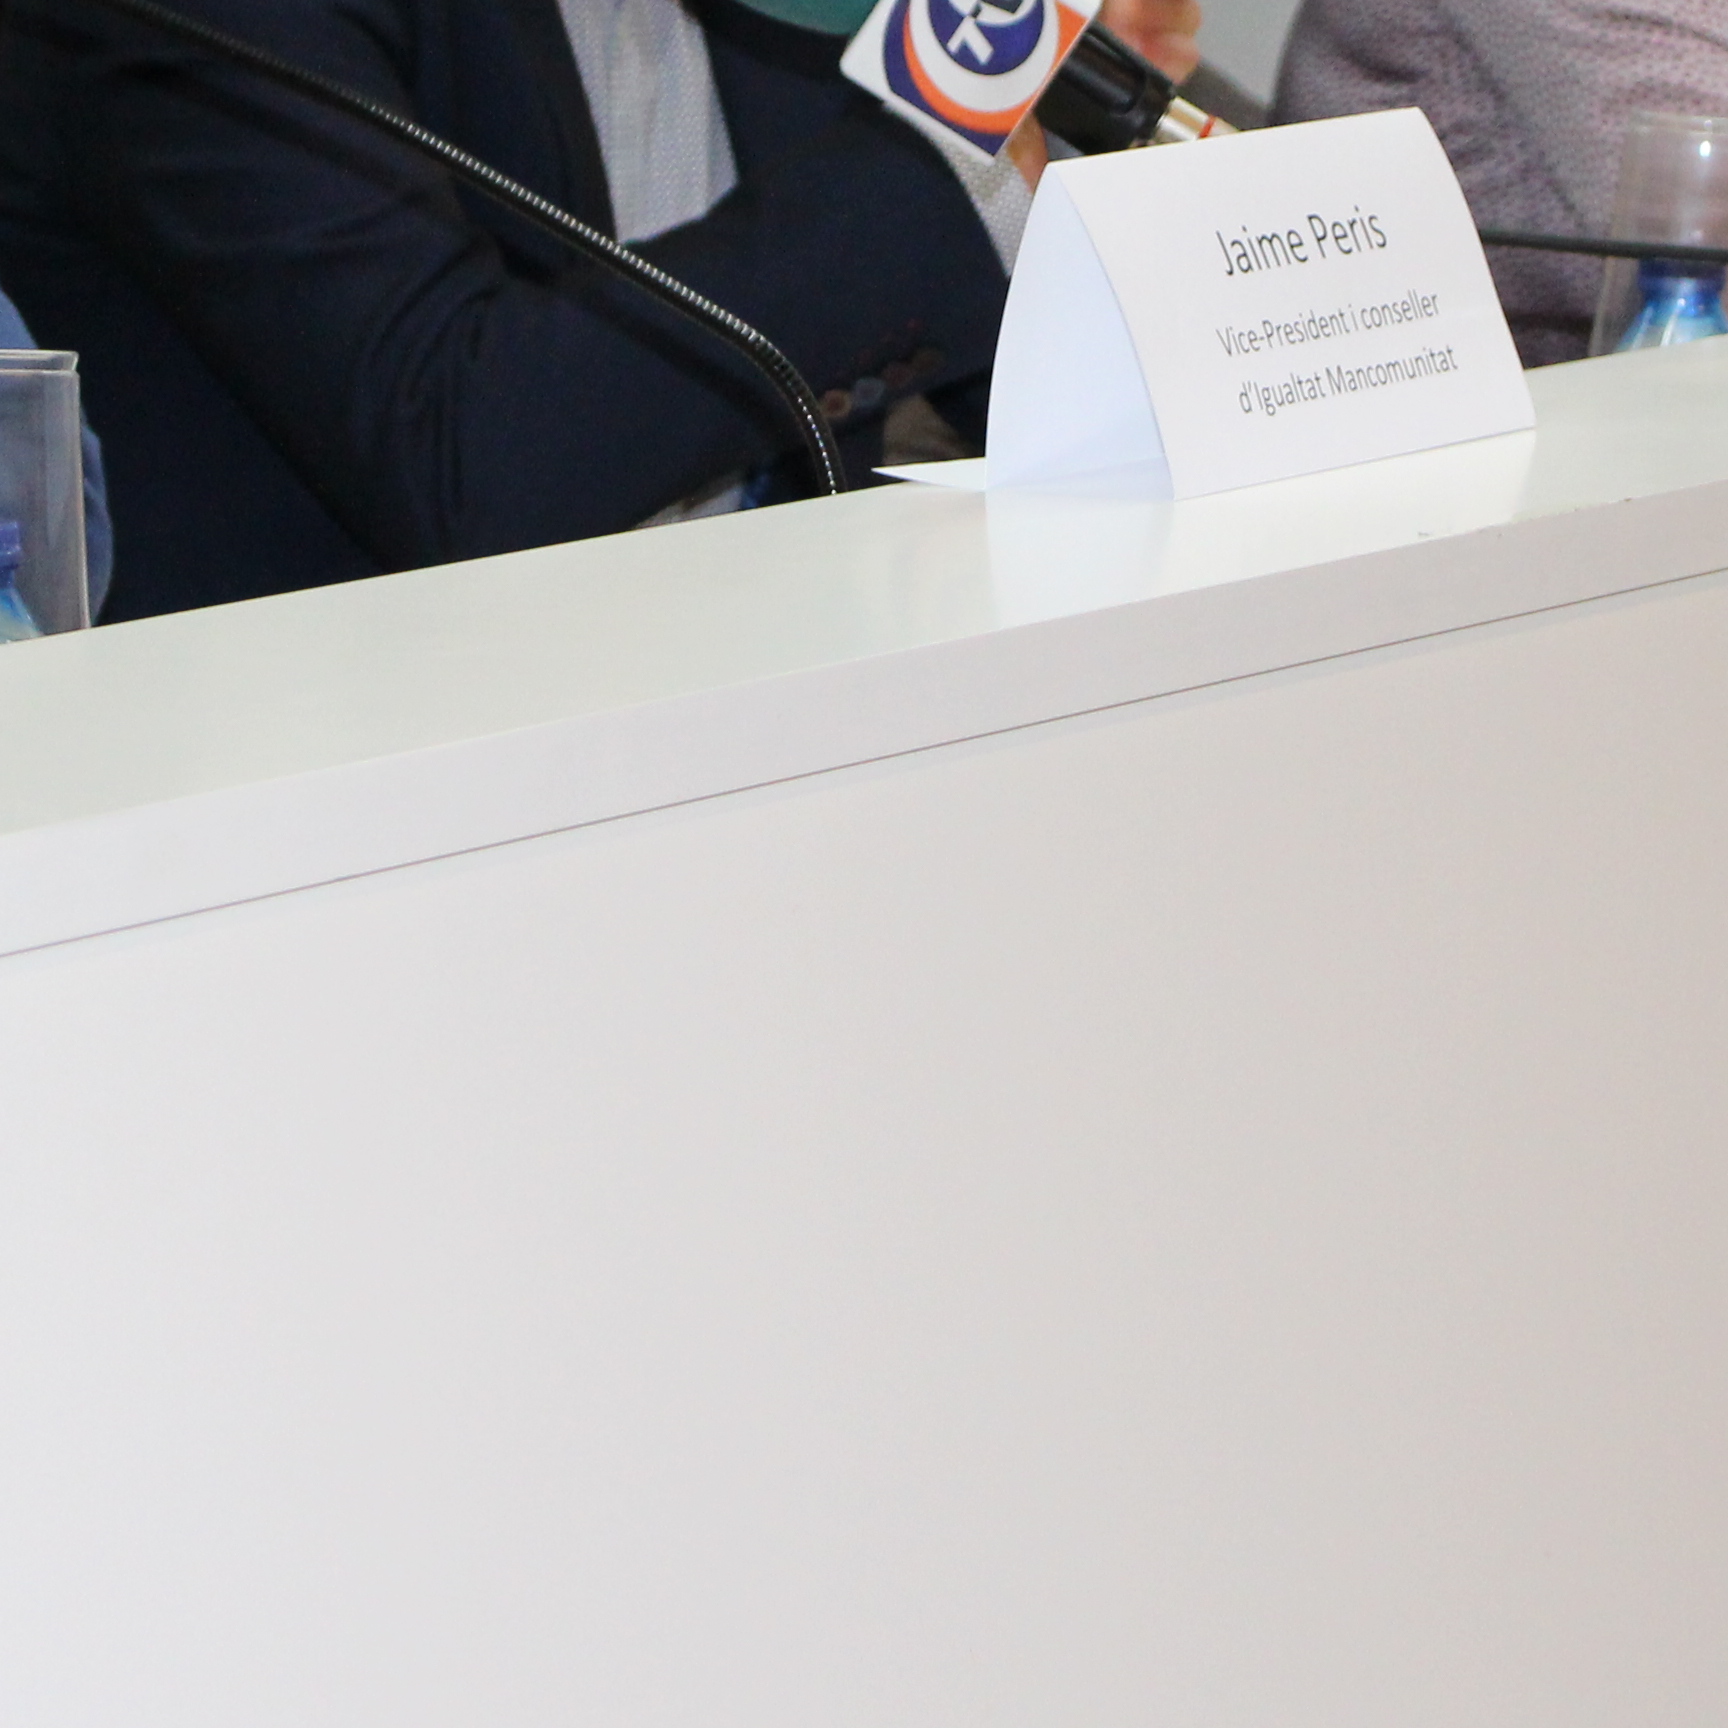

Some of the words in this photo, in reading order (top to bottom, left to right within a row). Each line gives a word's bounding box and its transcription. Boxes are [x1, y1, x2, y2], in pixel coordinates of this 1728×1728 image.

[1216, 225, 1308, 276] Jaime
[1307, 205, 1387, 259] Peris
[1216, 304, 1350, 357] Vice-President
[1348, 304, 1359, 333] i
[1360, 289, 1440, 330] conseller
[1325, 345, 1458, 396] Mancomunitat
